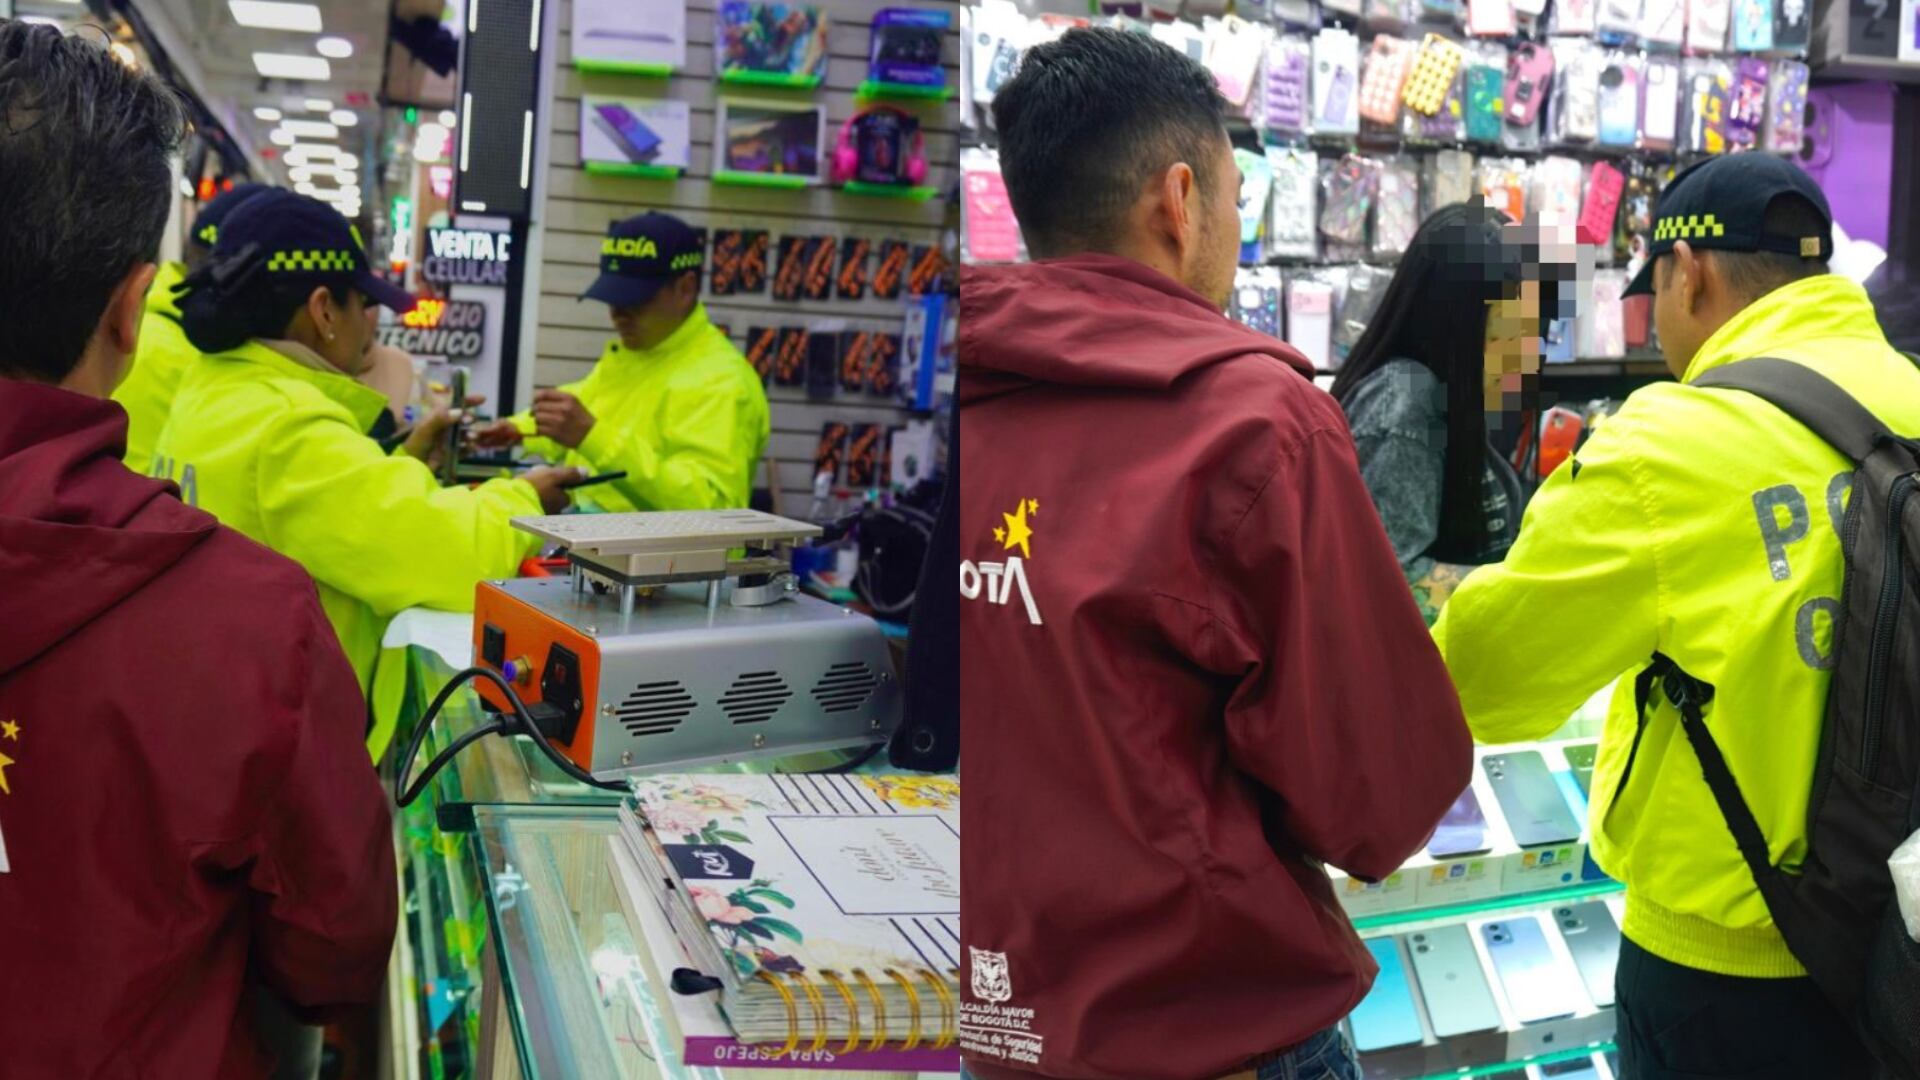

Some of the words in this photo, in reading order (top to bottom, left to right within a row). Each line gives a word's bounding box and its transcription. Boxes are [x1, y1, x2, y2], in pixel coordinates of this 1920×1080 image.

[429, 230, 494, 260] VENTA
[960, 1001, 999, 1015] LCALDÍA
[1001, 1006, 1034, 1019] MAYOR
